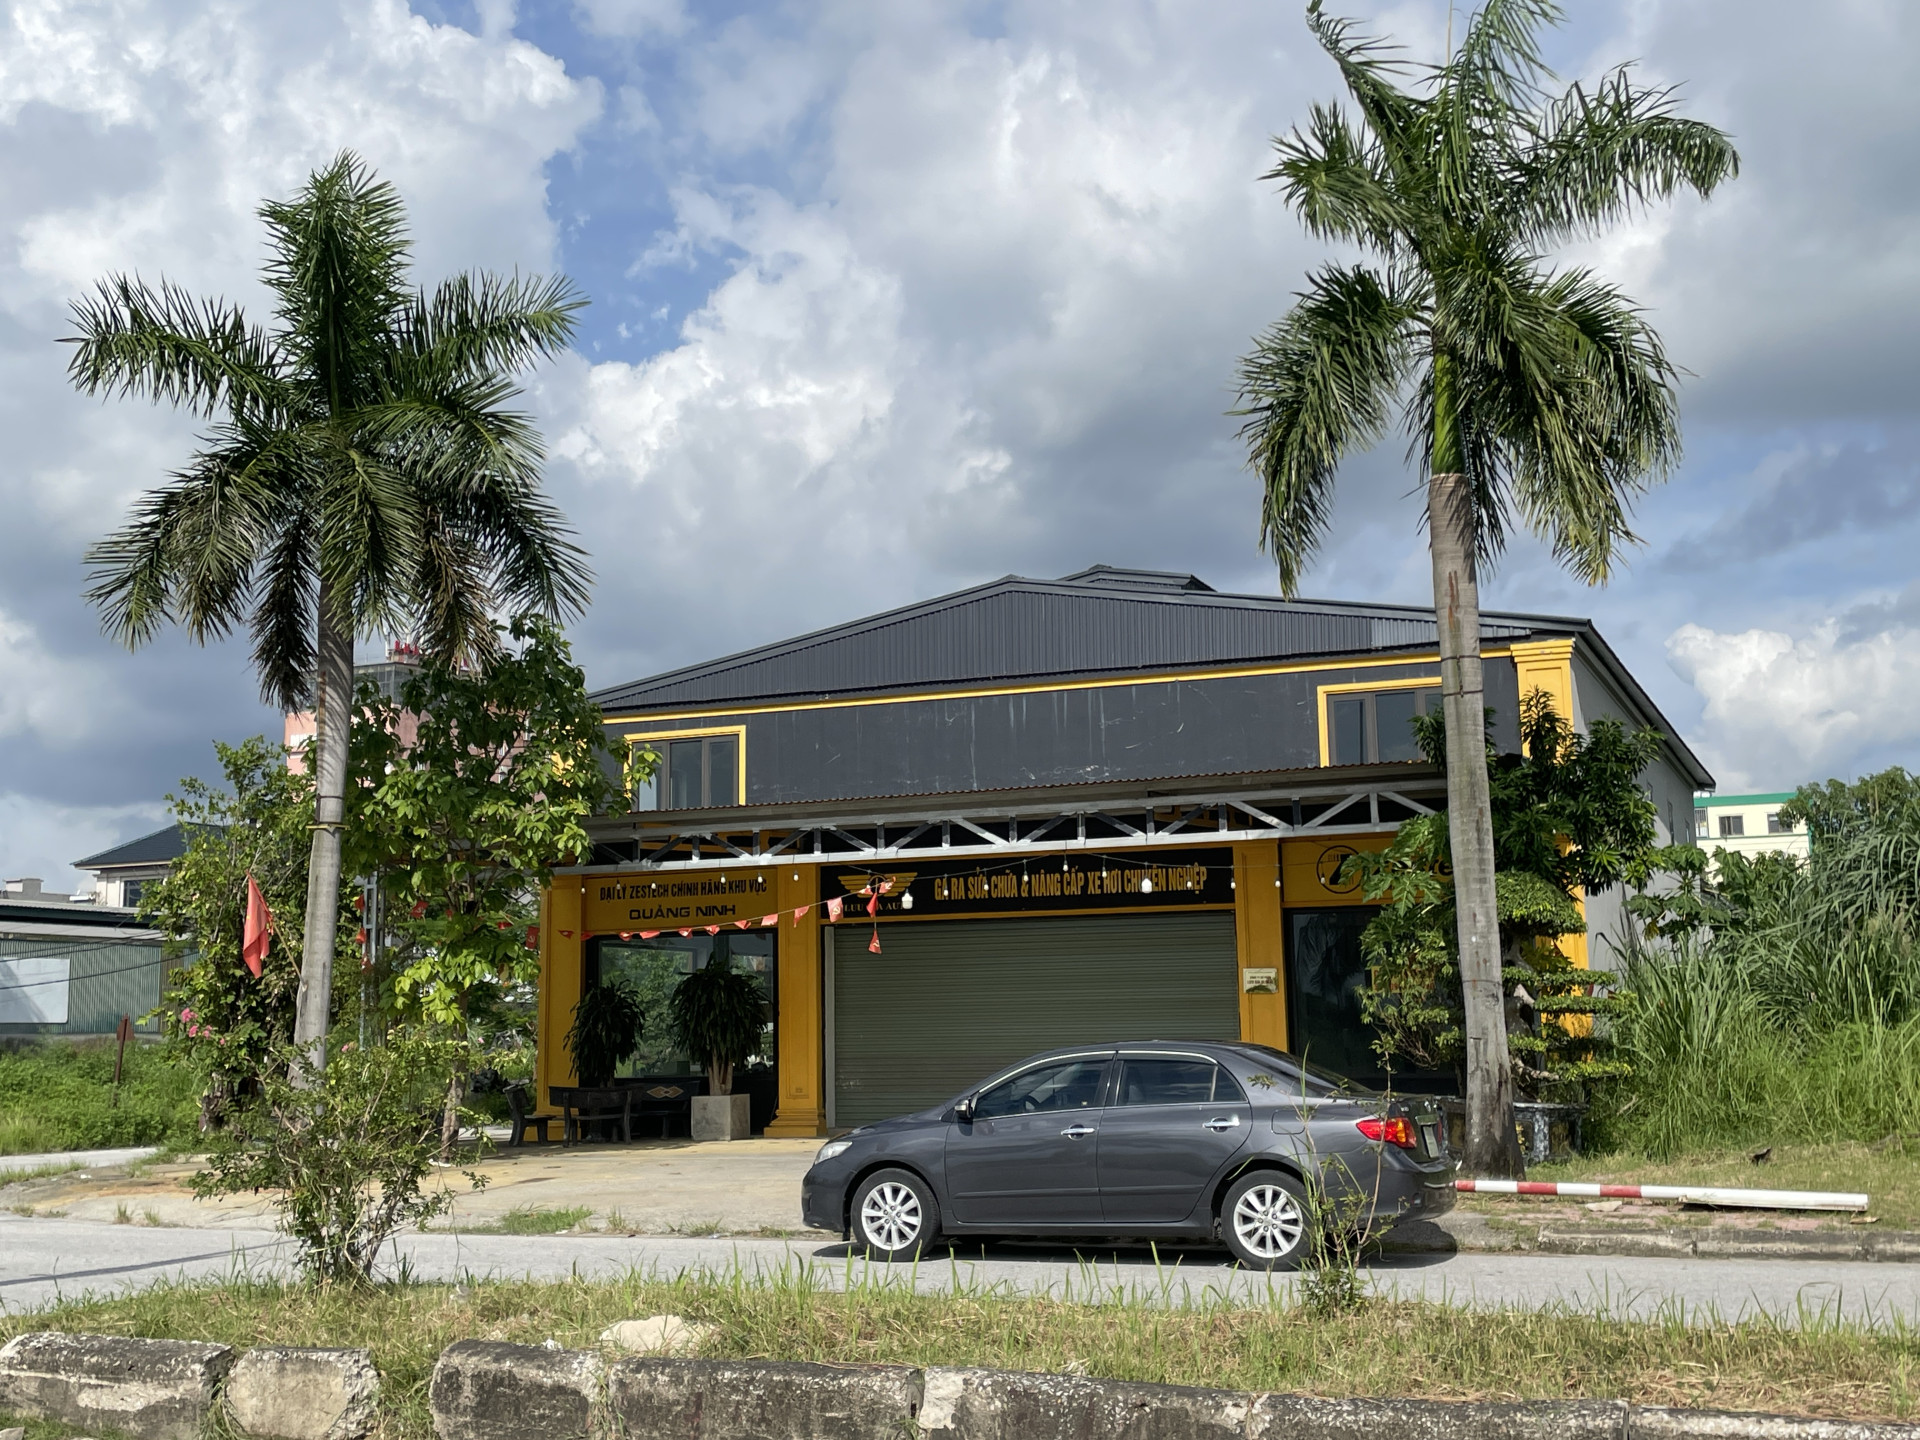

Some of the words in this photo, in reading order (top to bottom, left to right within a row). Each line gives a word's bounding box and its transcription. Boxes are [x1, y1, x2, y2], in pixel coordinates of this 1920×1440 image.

[671, 880, 699, 897] CHÍNH
[728, 879, 747, 894] KHU
[950, 876, 966, 900] RA
[990, 868, 1018, 898] CHỮA
[1020, 874, 1029, 897] &
[1031, 869, 1061, 897] NÂNG
[1063, 865, 1085, 896] CẤP
[1087, 870, 1102, 895] XE
[1103, 868, 1122, 894] HƠI
[629, 904, 691, 920] QUẢNG
[695, 904, 736, 917] NINH
